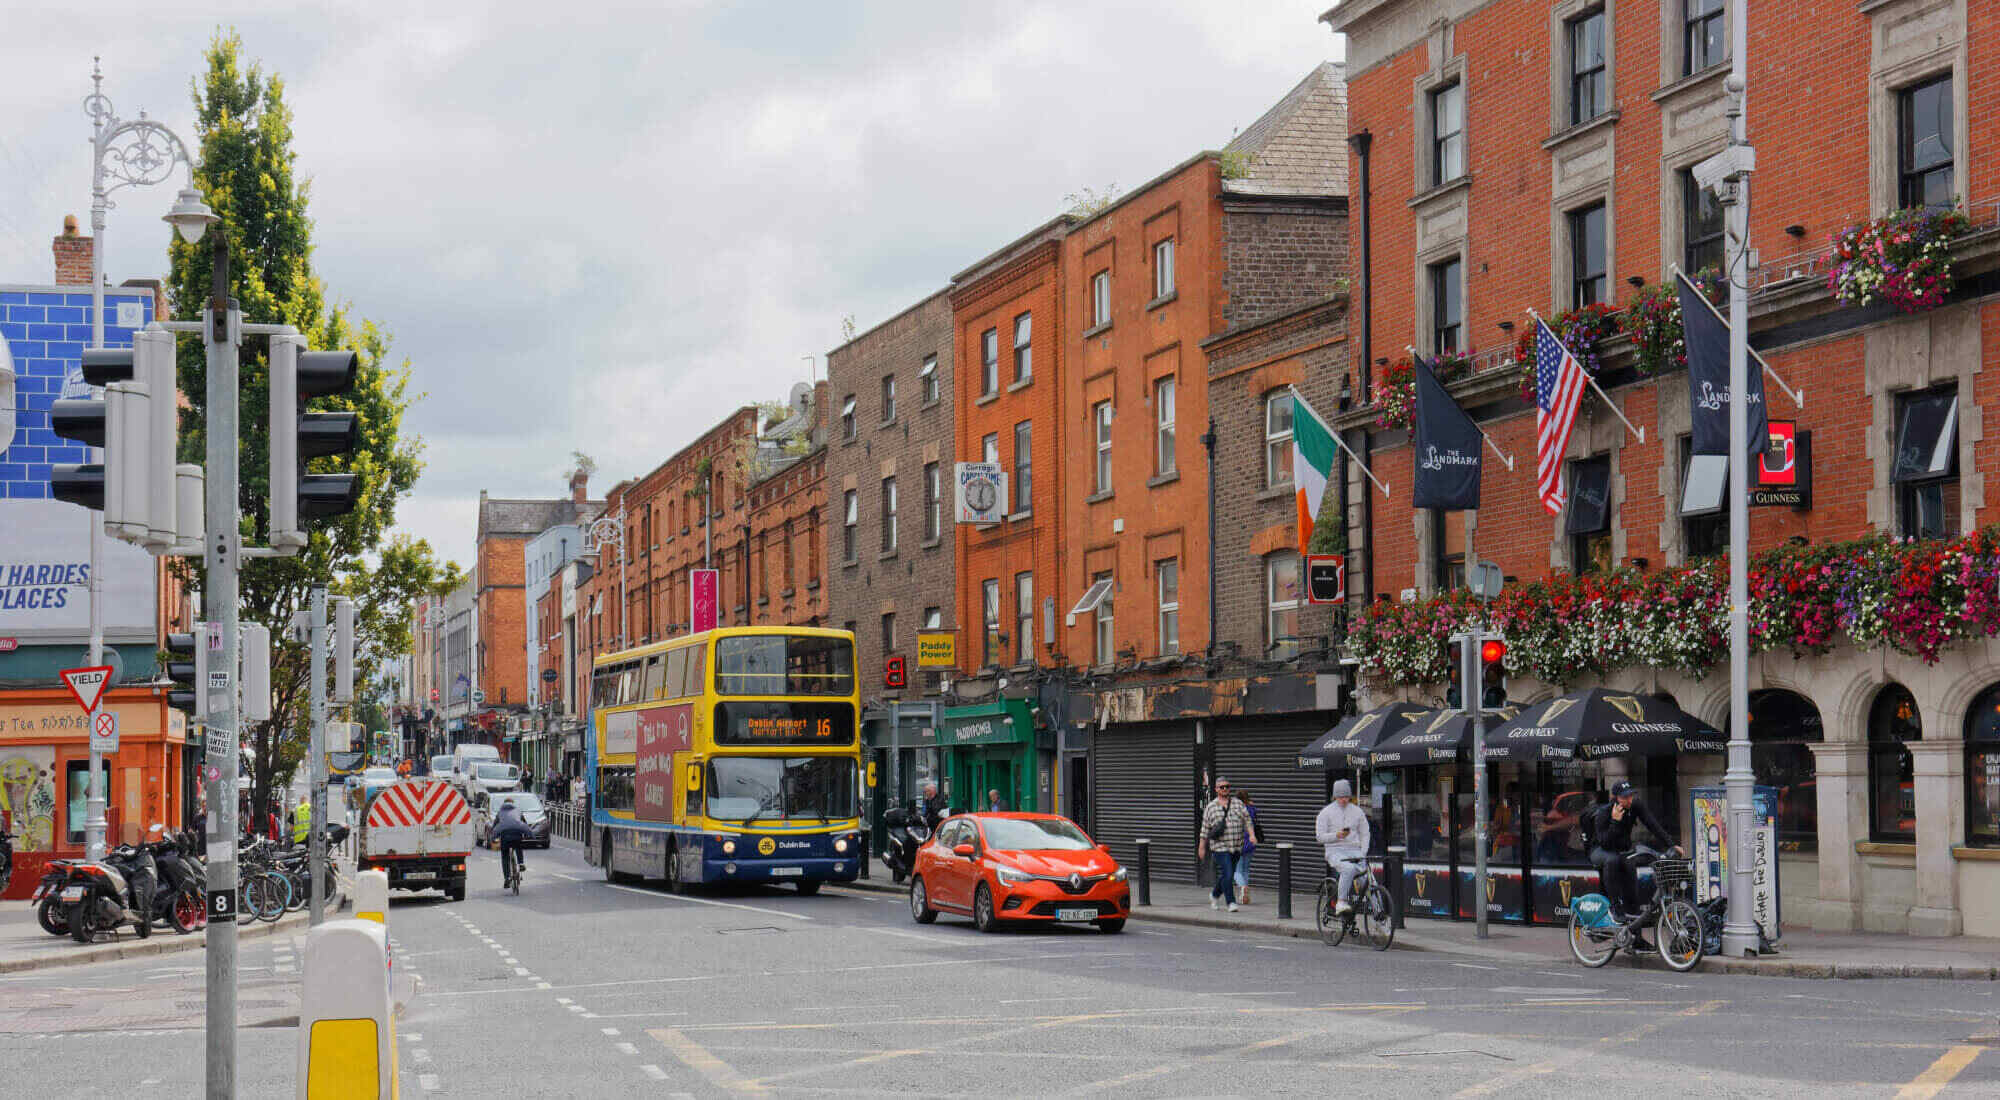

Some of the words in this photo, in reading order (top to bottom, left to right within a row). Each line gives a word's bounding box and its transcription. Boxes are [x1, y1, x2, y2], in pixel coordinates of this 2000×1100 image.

[1699, 381, 1760, 410] LANDRK
[1422, 446, 1478, 470] LANDMARK
[1756, 493, 1801, 504] GUINNESS
[8, 564, 91, 585] HARDES
[920, 641, 952, 651] Paddy
[71, 673, 103, 685] YIELD
[748, 719, 775, 728] Dublin
[776, 719, 807, 728] Airport
[816, 719, 832, 736] 16
[1610, 721, 1682, 734] GUINNESS
[1591, 743, 1630, 755] GUINNESS
[1683, 740, 1725, 750] GUINNESS
[215, 895, 227, 912] 8
